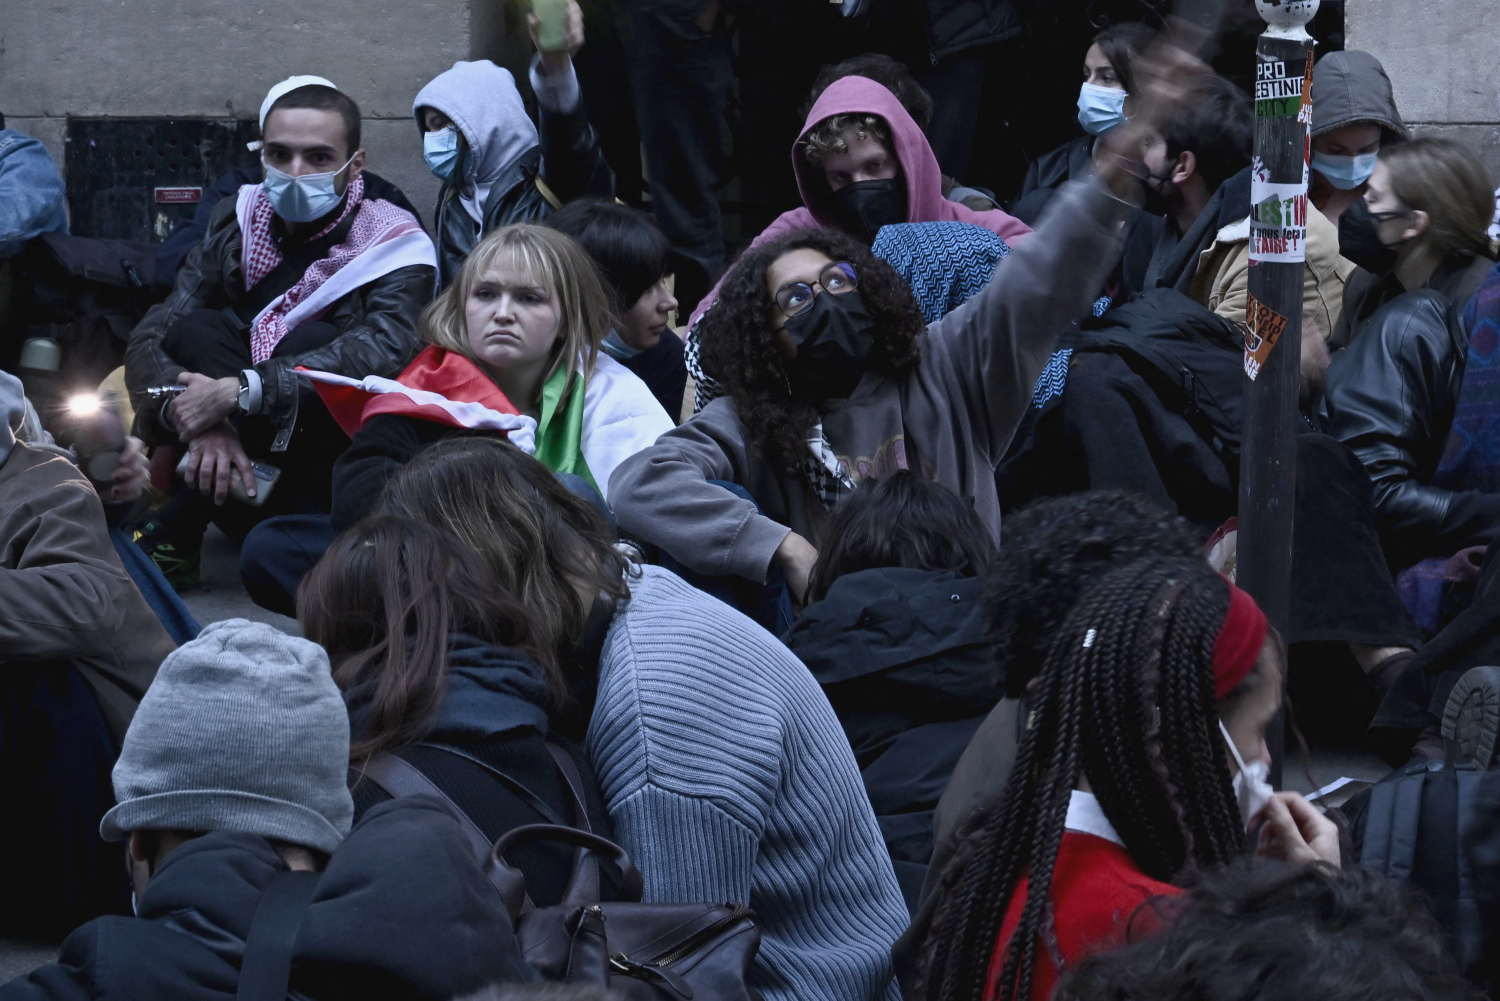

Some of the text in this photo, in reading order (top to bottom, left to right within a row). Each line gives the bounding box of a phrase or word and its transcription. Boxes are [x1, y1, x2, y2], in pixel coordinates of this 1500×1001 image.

[1258, 62, 1286, 80] PRO
[1258, 98, 1289, 117] CITY
[1257, 228, 1279, 239] nous
[1283, 228, 1300, 240] fera
[1255, 236, 1288, 254] TAIRE
